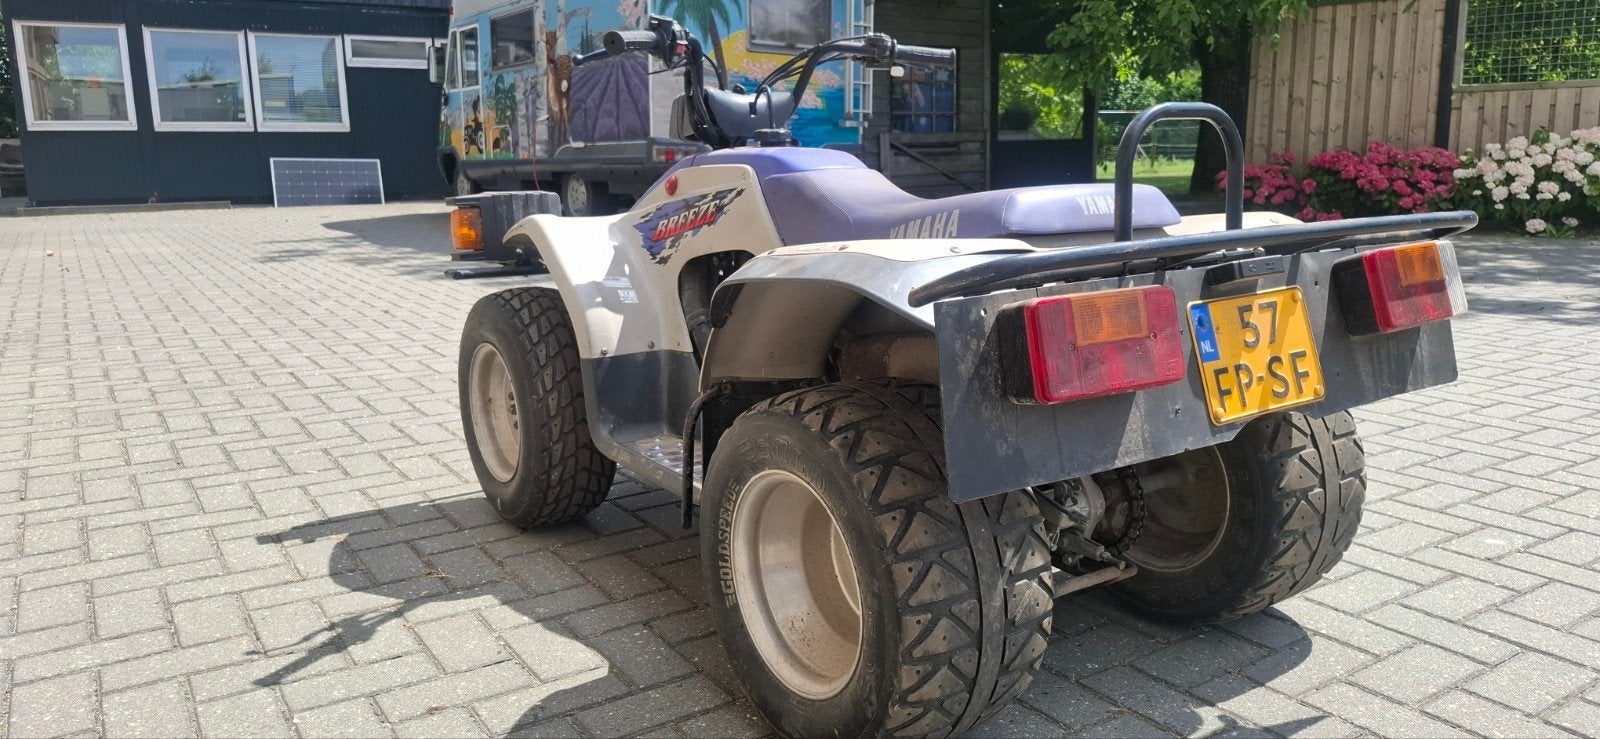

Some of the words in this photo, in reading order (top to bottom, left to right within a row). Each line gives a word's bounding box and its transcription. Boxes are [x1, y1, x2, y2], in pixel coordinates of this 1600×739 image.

[652, 200, 721, 241] BREEZE
[1075, 195, 1135, 215] YAMA
[1237, 300, 1278, 349] 57
[1200, 340, 1215, 354] NL
[1213, 350, 1310, 412] FP-SF
